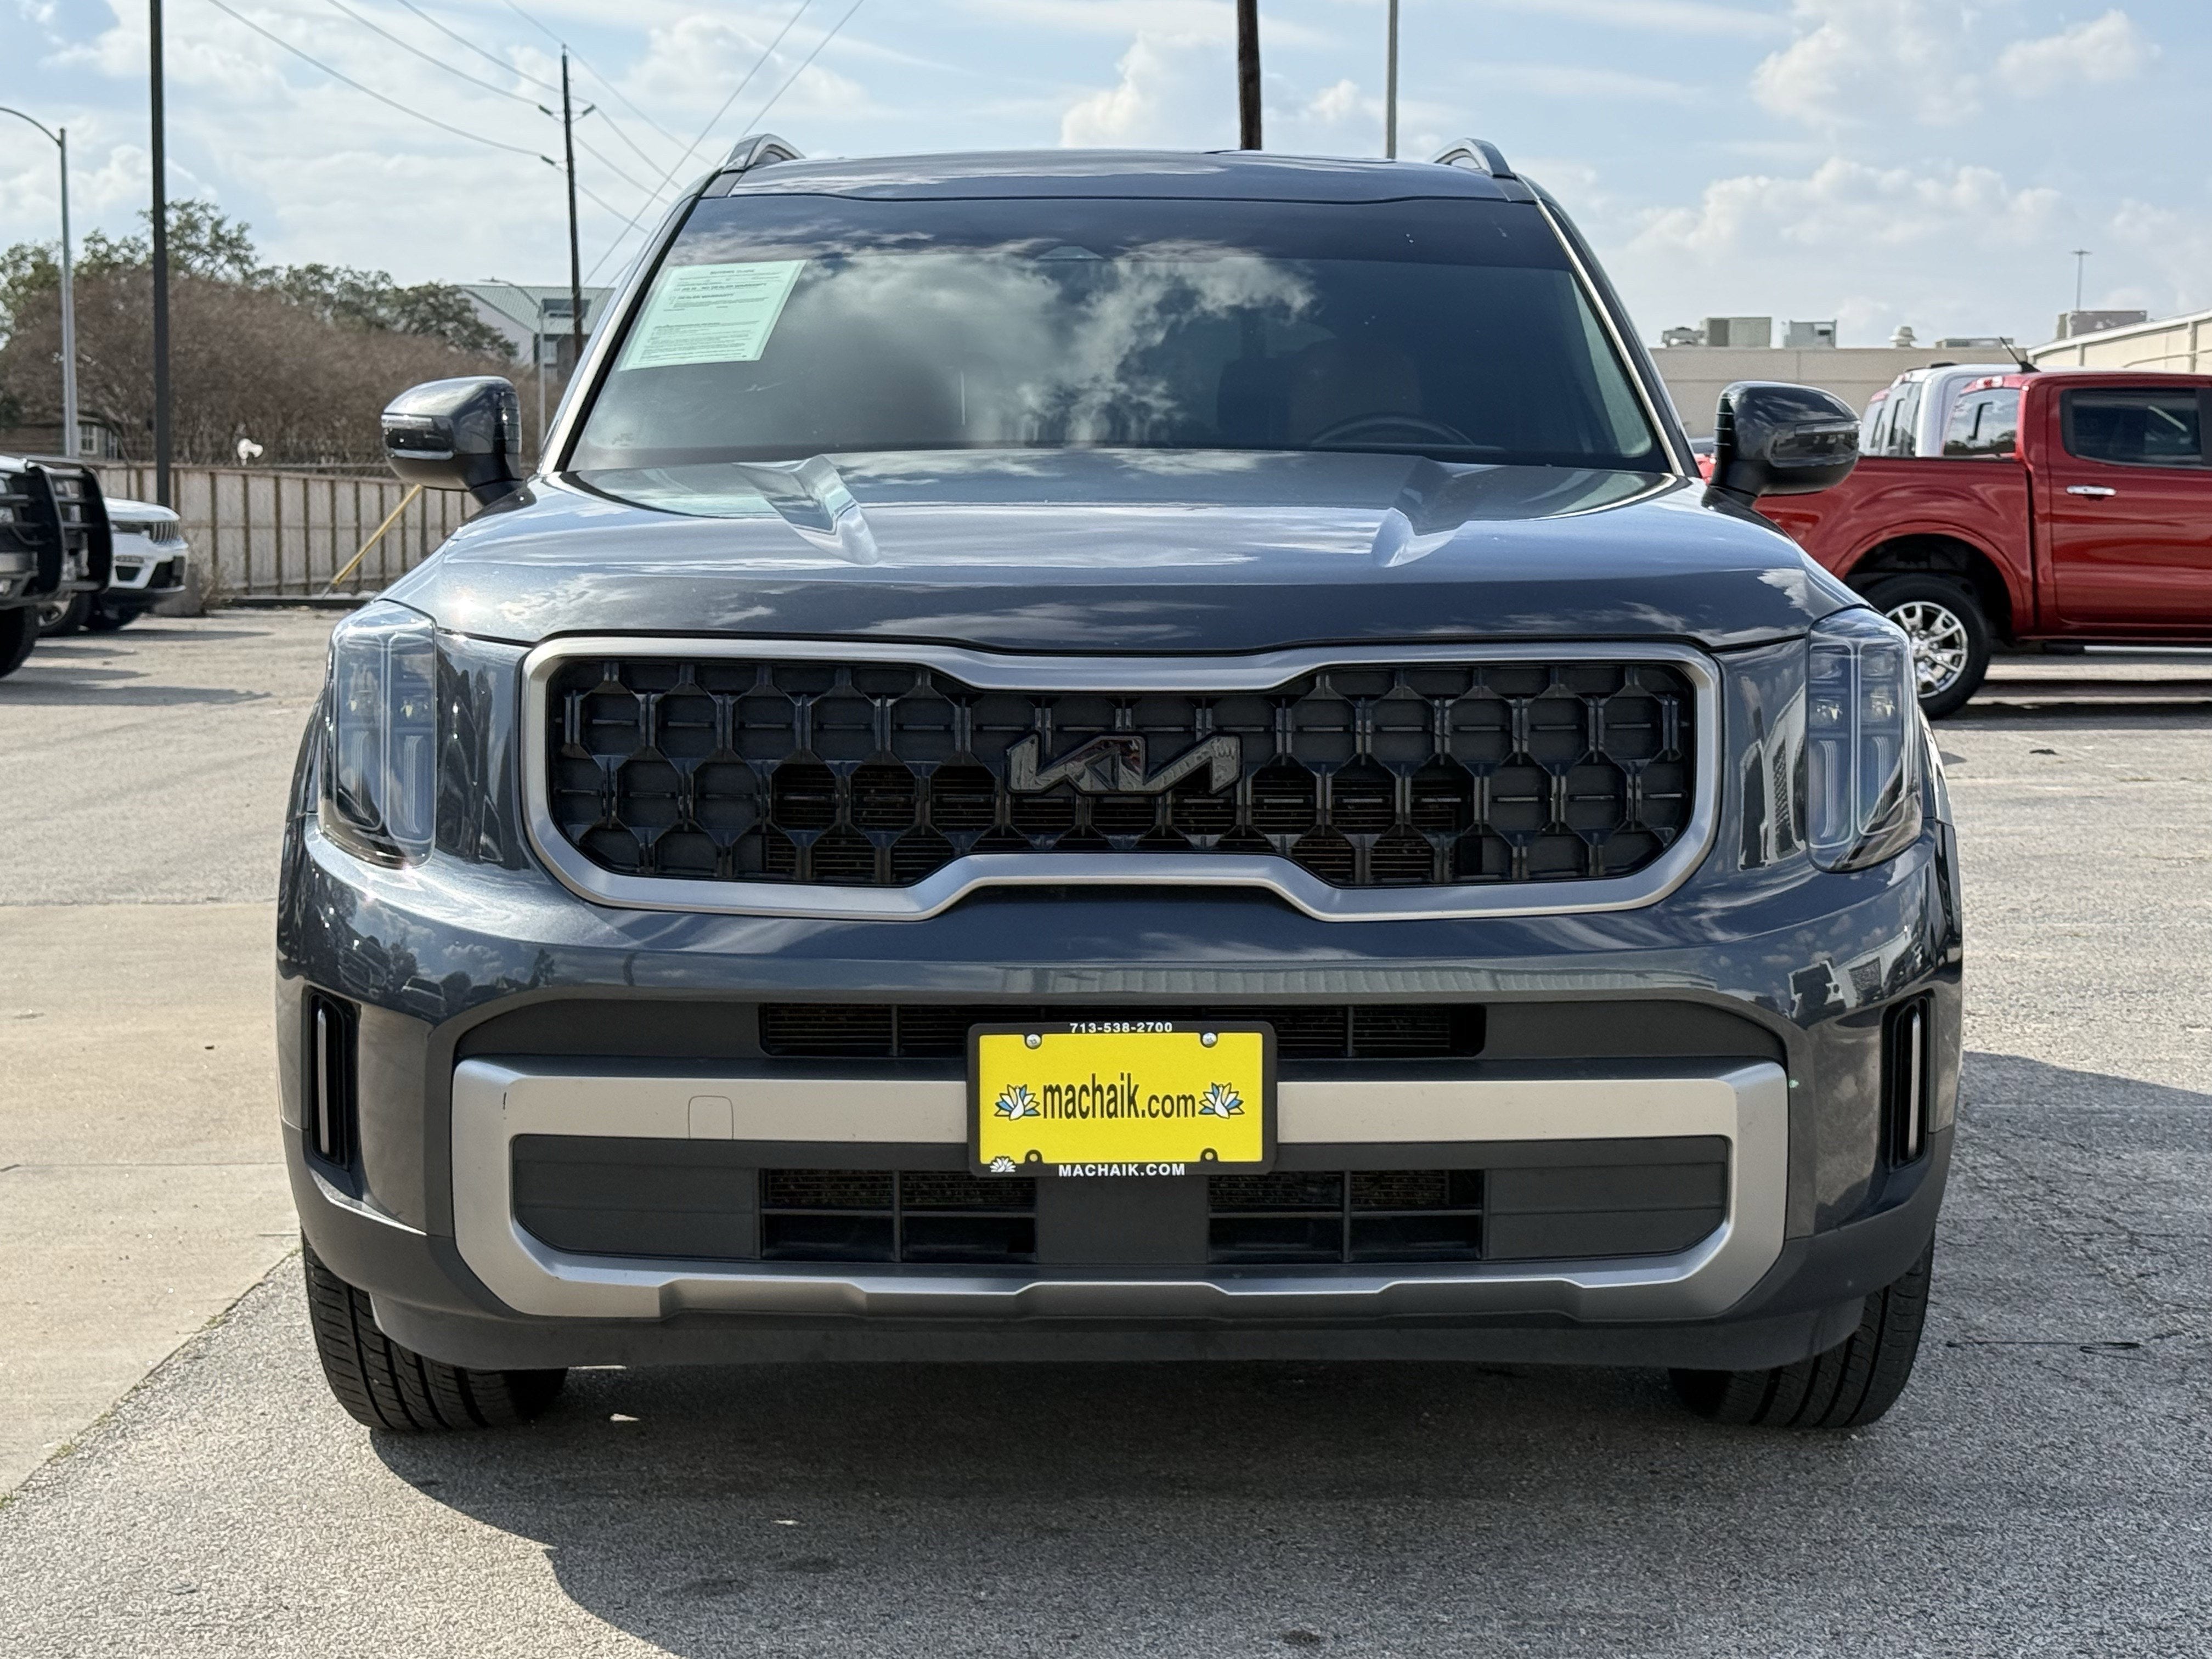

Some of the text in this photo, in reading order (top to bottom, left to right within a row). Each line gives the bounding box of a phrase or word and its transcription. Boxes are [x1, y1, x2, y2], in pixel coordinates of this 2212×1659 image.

[1008, 733, 1240, 794] KIA
[1069, 1022, 1173, 1033] 713-538-2700
[1042, 1072, 1196, 1119] machaik.com
[1058, 1163, 1186, 1177] MACHAIK.COM
